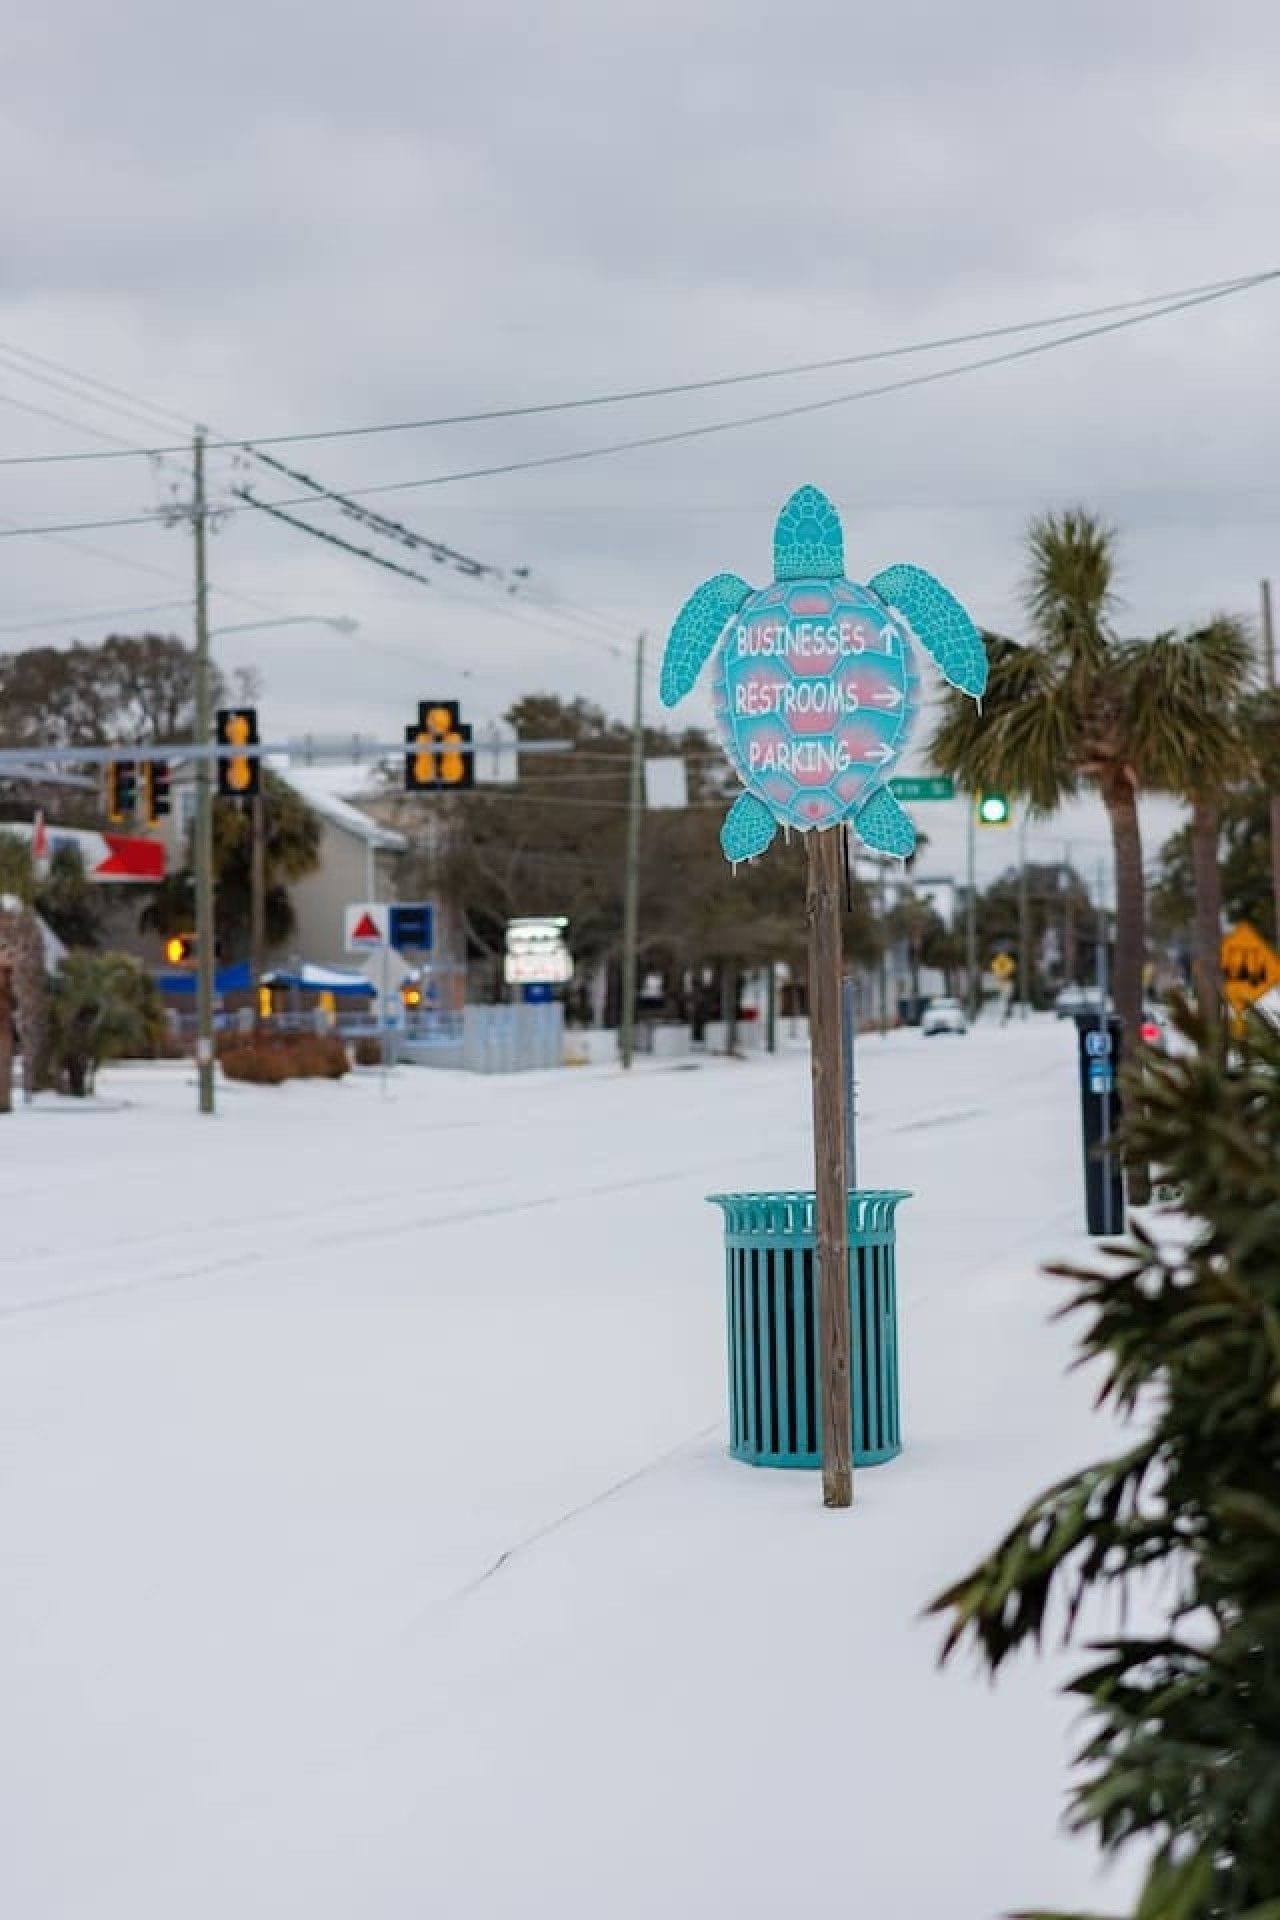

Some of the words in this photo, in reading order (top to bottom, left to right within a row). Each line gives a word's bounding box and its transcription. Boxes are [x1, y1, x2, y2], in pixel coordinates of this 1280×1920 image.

[737, 624, 865, 656] BUSINESSES
[735, 683, 858, 714] RESTROOMS
[749, 741, 849, 774] PARKING
